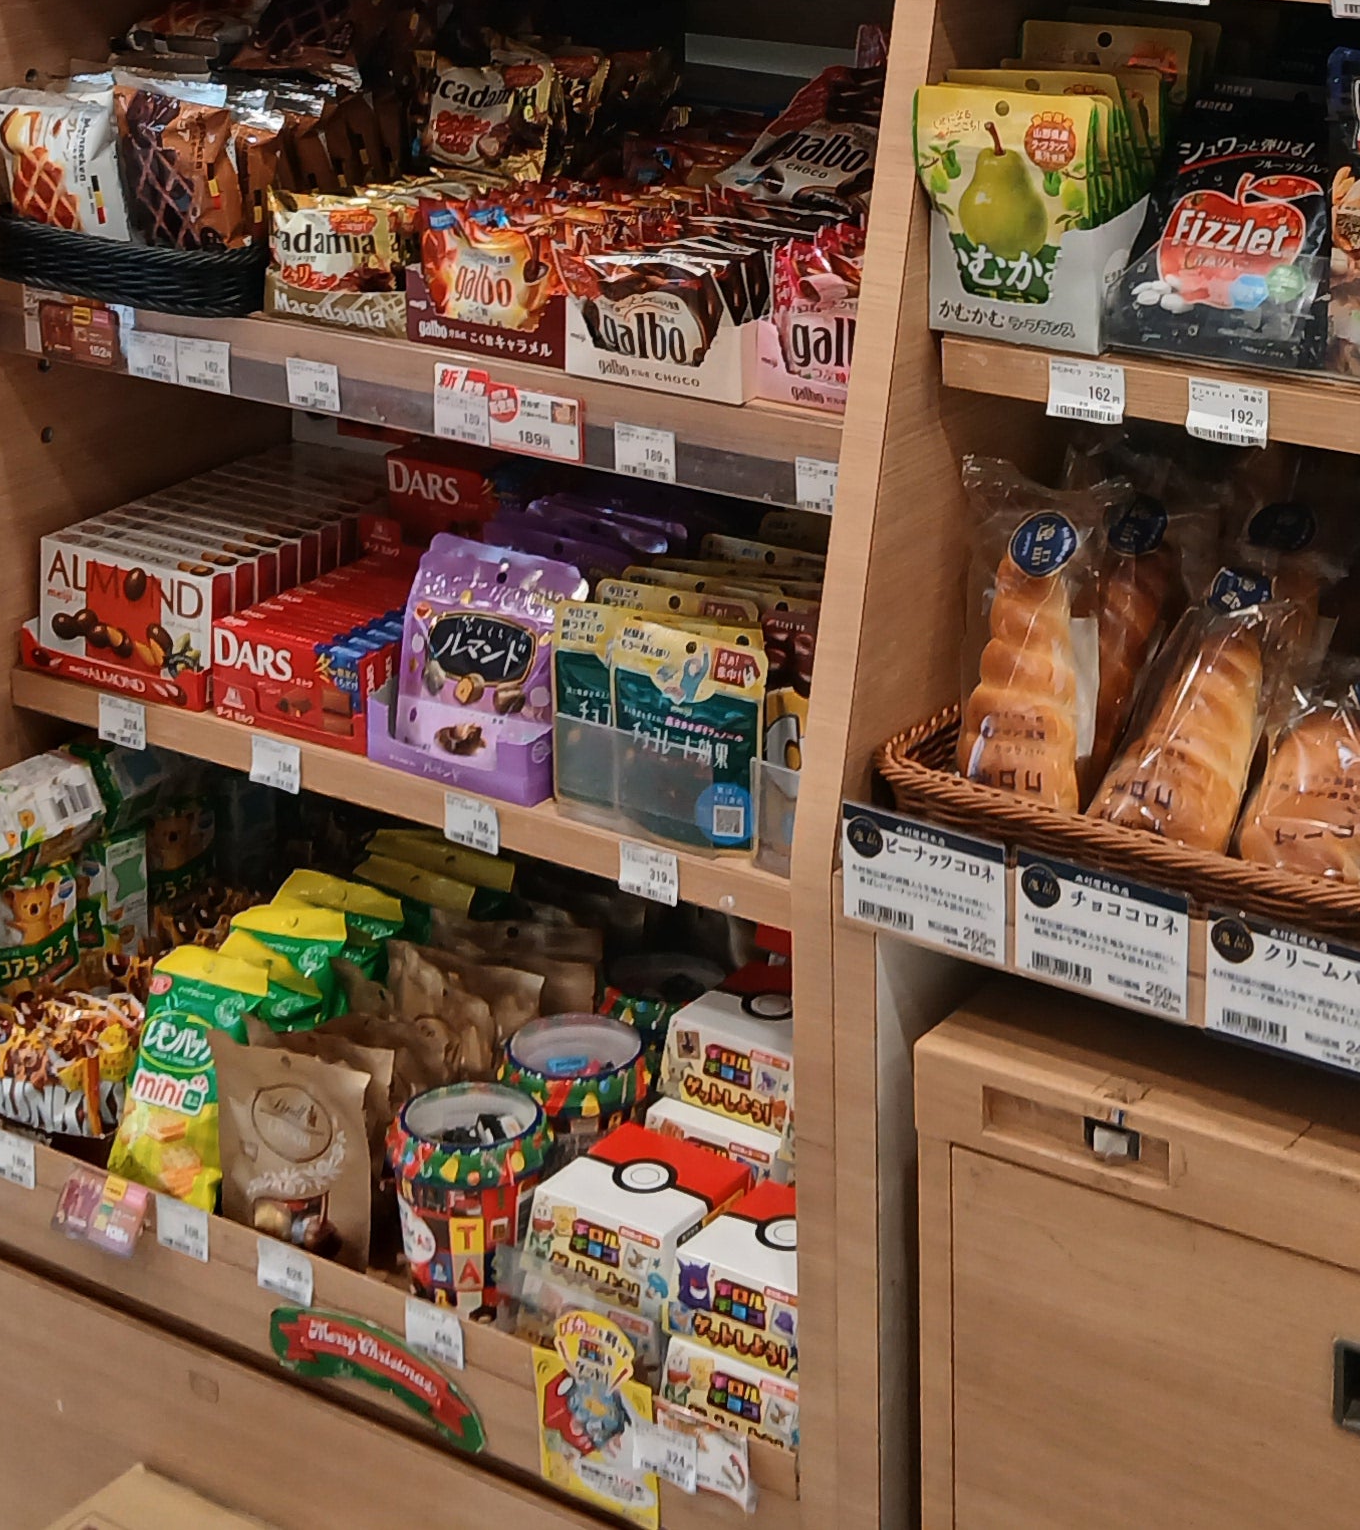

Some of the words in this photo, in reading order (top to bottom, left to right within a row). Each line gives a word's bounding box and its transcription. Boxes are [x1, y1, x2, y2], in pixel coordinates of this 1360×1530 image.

[1171, 208, 1292, 258] Fizzlet
[273, 288, 386, 328] Macadamia
[454, 263, 513, 310] galbo
[939, 299, 1006, 329] かむかむ
[603, 313, 688, 363] galbo
[654, 372, 701, 388] CHOCO
[1087, 386, 1121, 405] 162円
[518, 430, 551, 449] 189円
[1229, 410, 1264, 428] 192円
[213, 628, 293, 682] DARS
[439, 632, 529, 676] ルマンド
[884, 835, 996, 884] ピーナッツコロネ
[1070, 890, 1180, 936] チョココロネ
[132, 1071, 184, 1104] mini
[308, 1319, 357, 1357] Merry
[357, 1328, 439, 1399] Christmas
